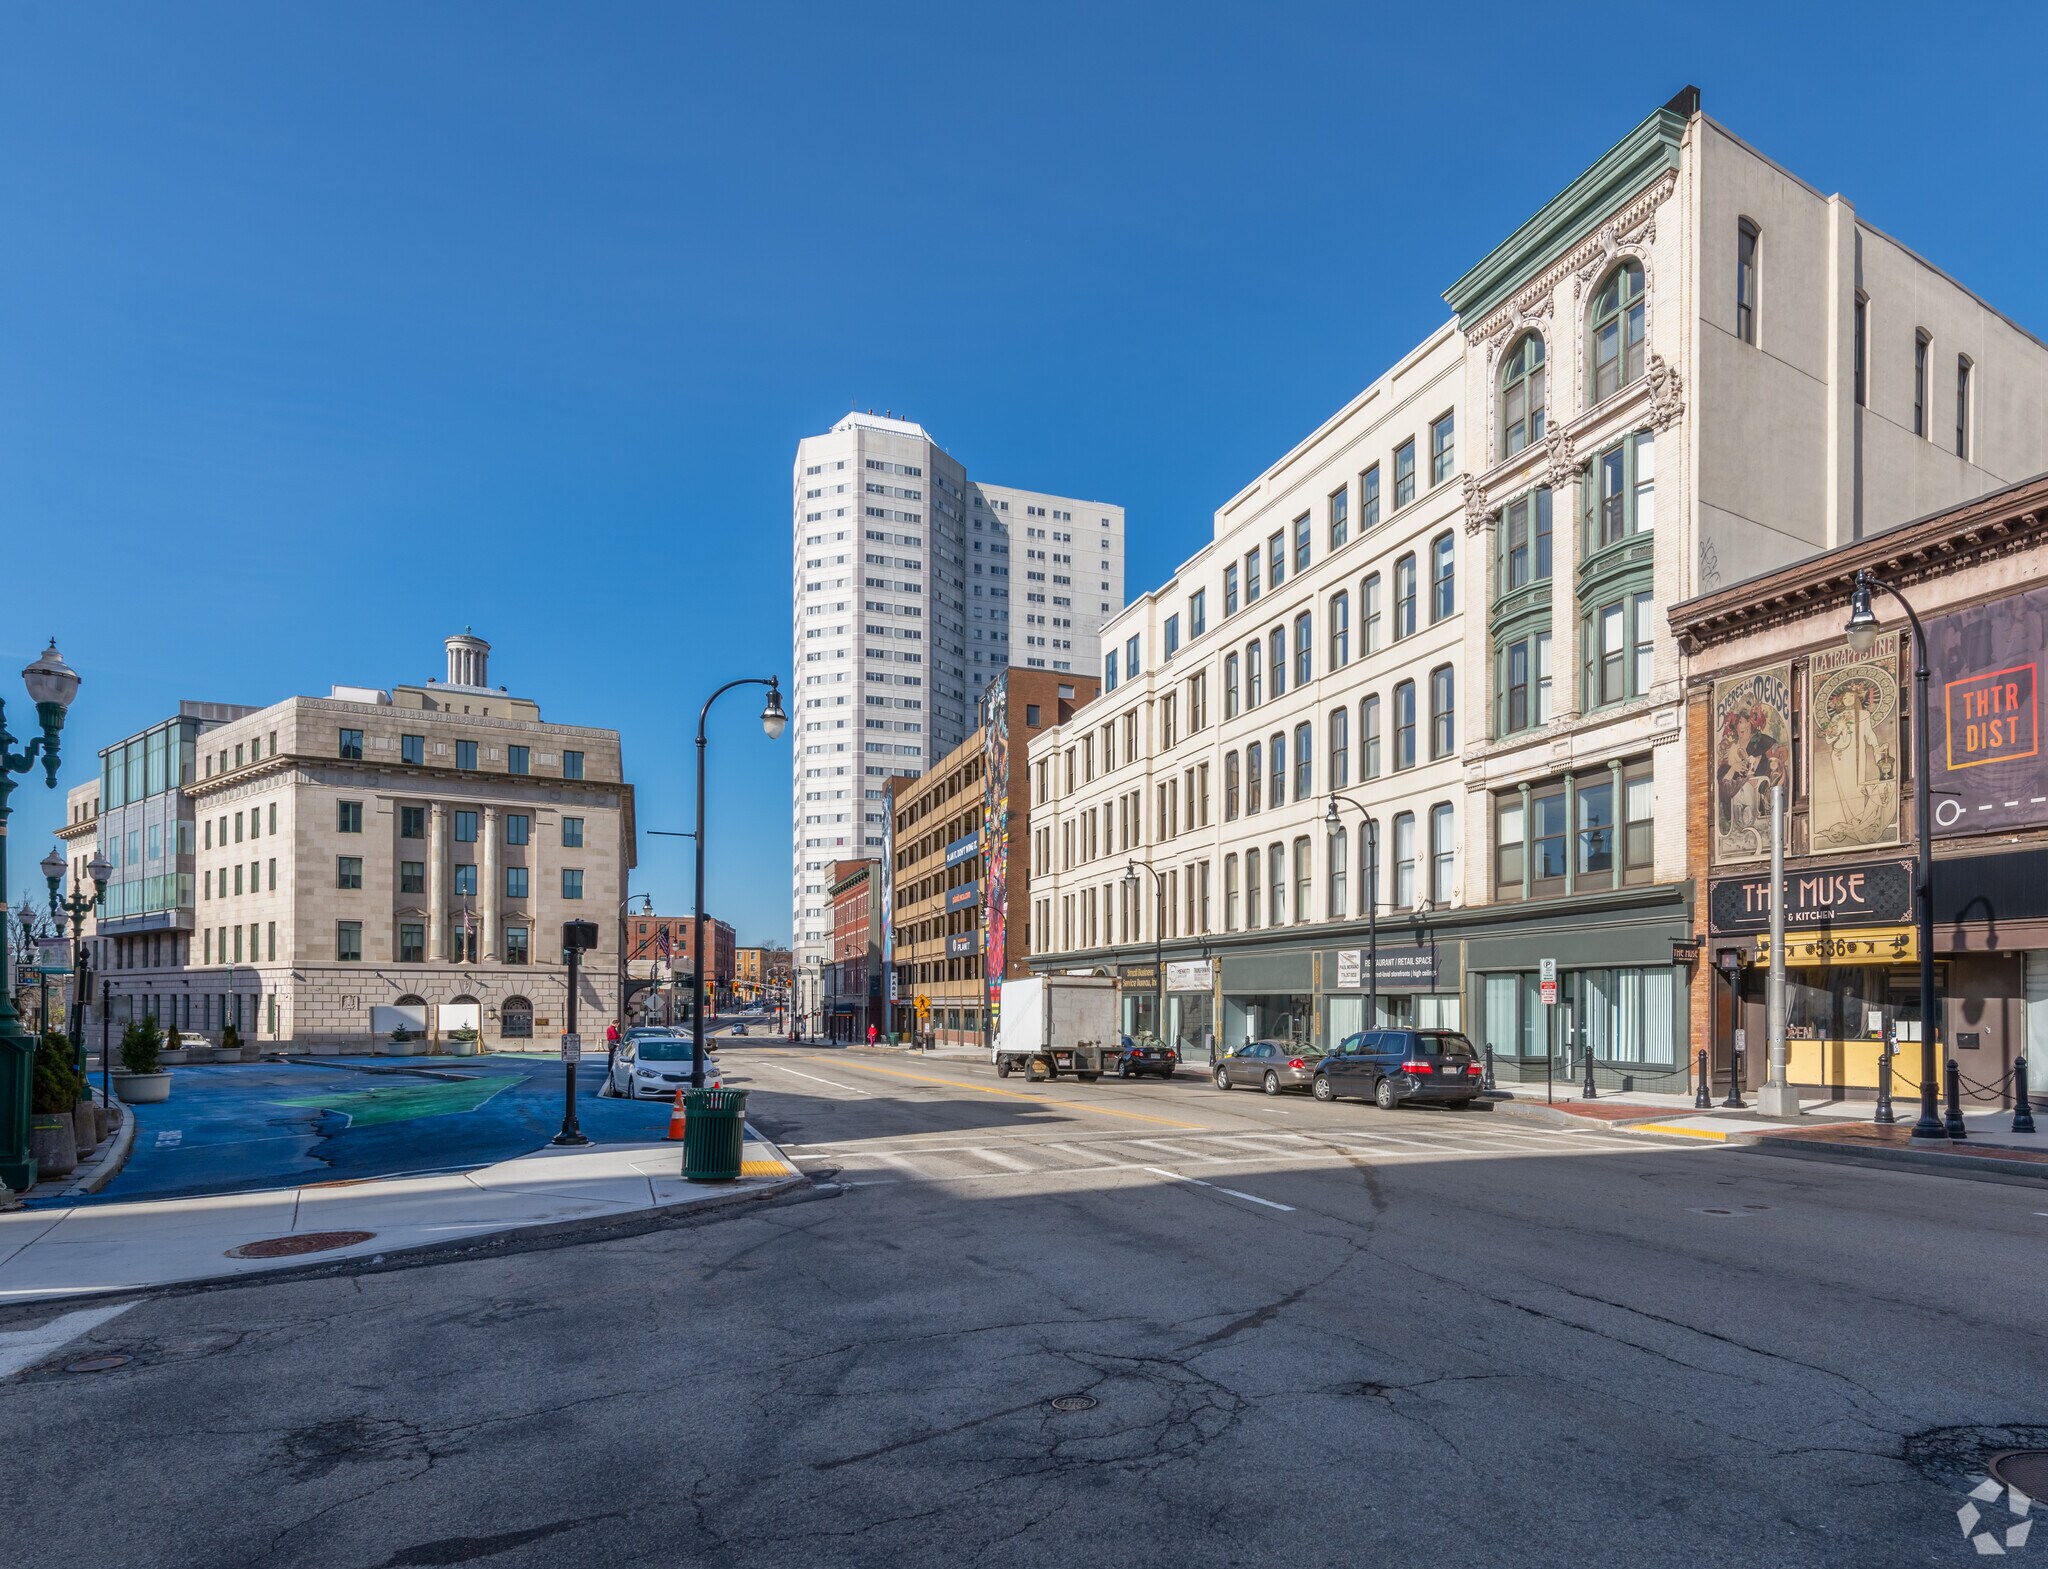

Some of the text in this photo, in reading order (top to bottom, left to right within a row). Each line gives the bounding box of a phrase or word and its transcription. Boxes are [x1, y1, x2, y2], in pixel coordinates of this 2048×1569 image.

[1753, 675, 1790, 720] MEUSE
[1963, 683, 2019, 720] THTR
[1966, 715, 2019, 752] DIST
[1800, 873, 1865, 908] MUSE
[1795, 910, 1835, 921] KITCHEN
[1673, 948, 1699, 958] THE MUSE
[1815, 938, 1846, 958] 536
[1365, 958, 1394, 967] REAURANT
[1398, 957, 1414, 966] RETAIL
[1416, 956, 1432, 965] SPACE
[1127, 968, 1154, 977] Small Business
[1413, 970, 1421, 978] high
